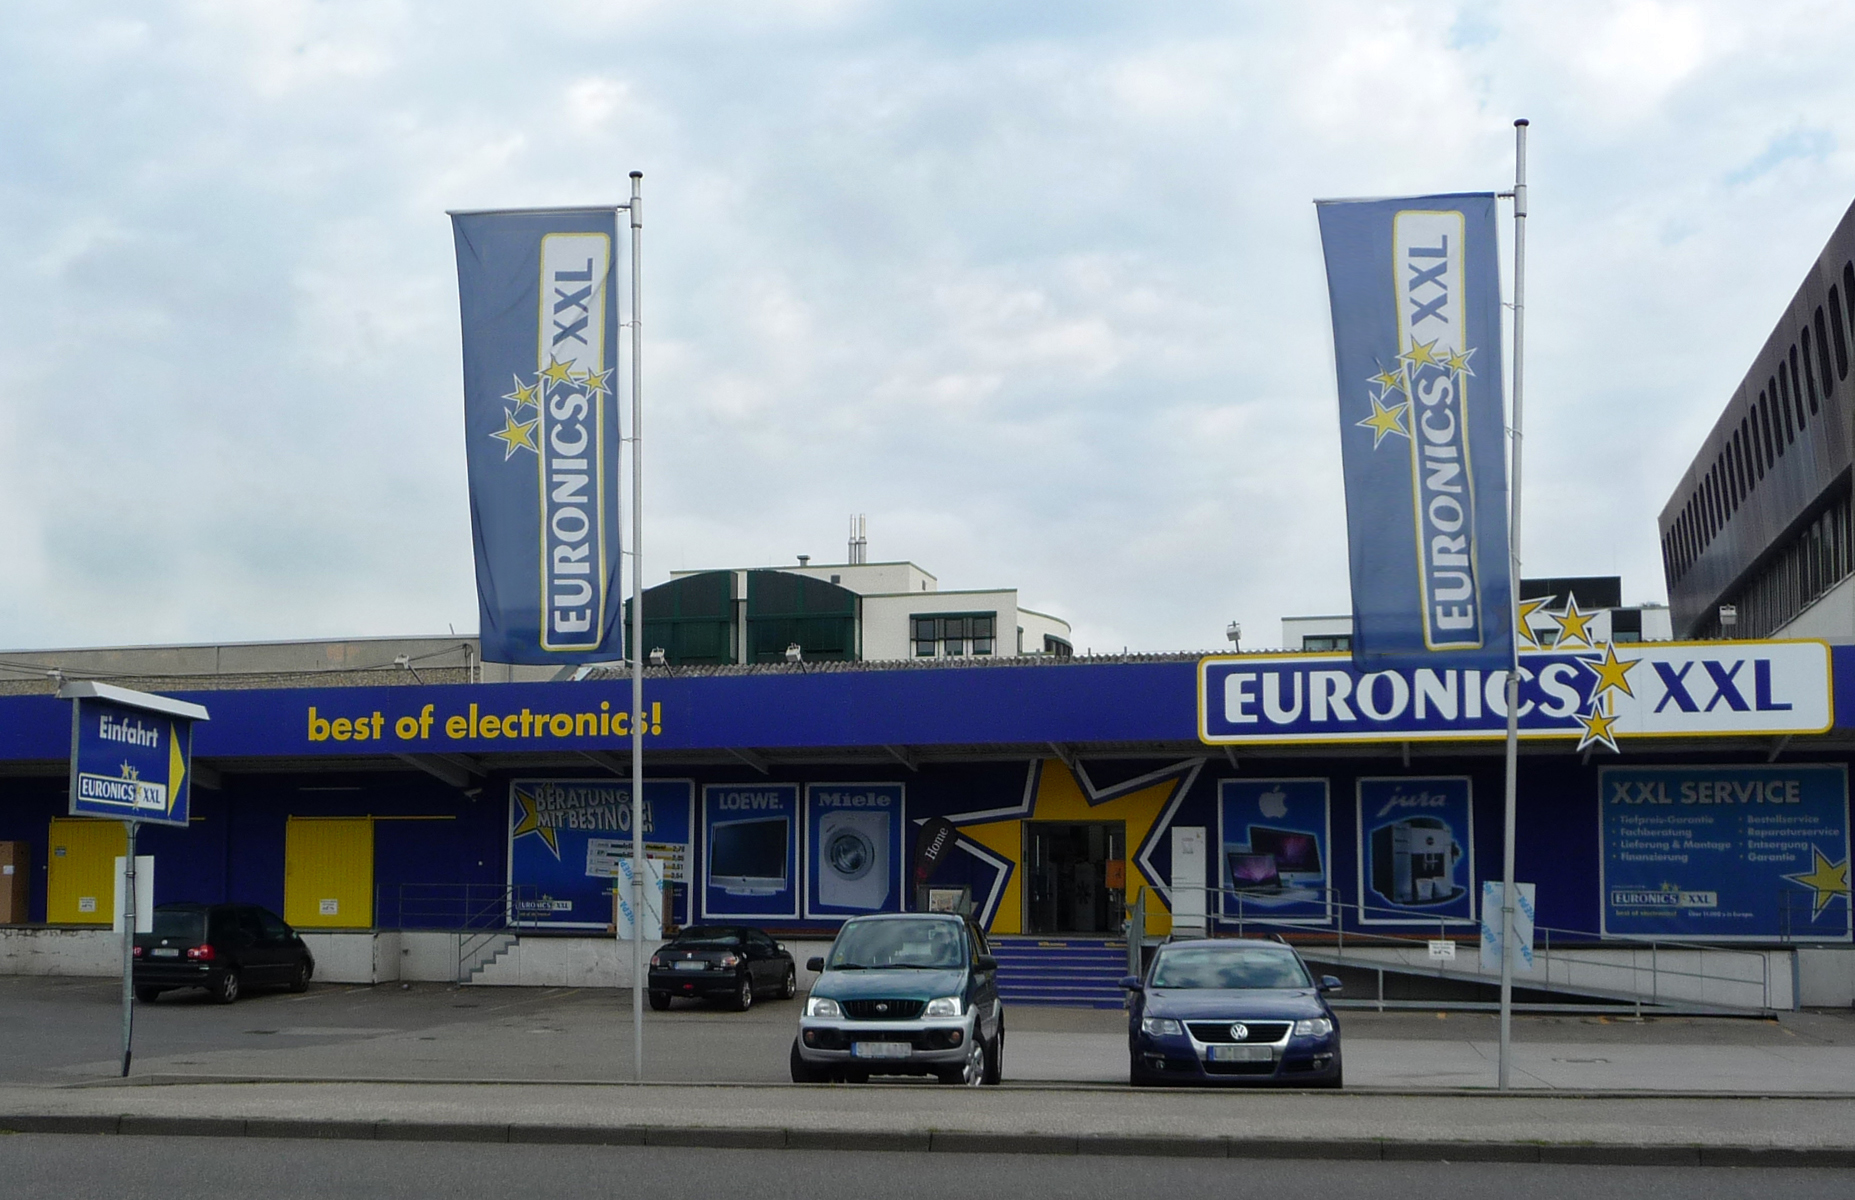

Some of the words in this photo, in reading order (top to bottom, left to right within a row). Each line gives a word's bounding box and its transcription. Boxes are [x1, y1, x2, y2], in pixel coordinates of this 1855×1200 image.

[1408, 235, 1448, 327] XXL
[553, 258, 594, 346] XXL
[550, 393, 593, 633] EURONICS
[1418, 376, 1473, 630] EURONICS
[1224, 663, 1582, 724] EURONICS
[1654, 659, 1793, 713] XXL
[99, 715, 158, 748] Einfahrt
[308, 706, 384, 741] best
[395, 704, 434, 740] of
[445, 701, 662, 739] electronics!
[82, 778, 134, 801] EURONICS
[143, 786, 161, 804] XXL
[535, 786, 630, 811] BERATUNG
[719, 792, 784, 810] LOEWE.
[818, 792, 892, 807] Miele
[1377, 786, 1447, 817] jura
[1611, 781, 1672, 804] XXL
[1680, 780, 1800, 804] SERVICE
[537, 810, 564, 829] MIT
[568, 801, 654, 833] BESTNOE!
[1747, 815, 1820, 824] Bestellservice
[925, 827, 949, 860] Home
[1620, 828, 1692, 838] Fachberatung
[1620, 840, 1670, 850] Lieferung
[1672, 840, 1681, 849] &
[1683, 840, 1731, 850] Montage
[1747, 828, 1840, 838] Reparaturservice
[1747, 840, 1808, 850] Entsorgung
[1620, 853, 1689, 863] Finanzierung
[1747, 852, 1796, 862] Garantie
[1615, 892, 1677, 904] EURONICS
[1688, 894, 1709, 904] XXL
